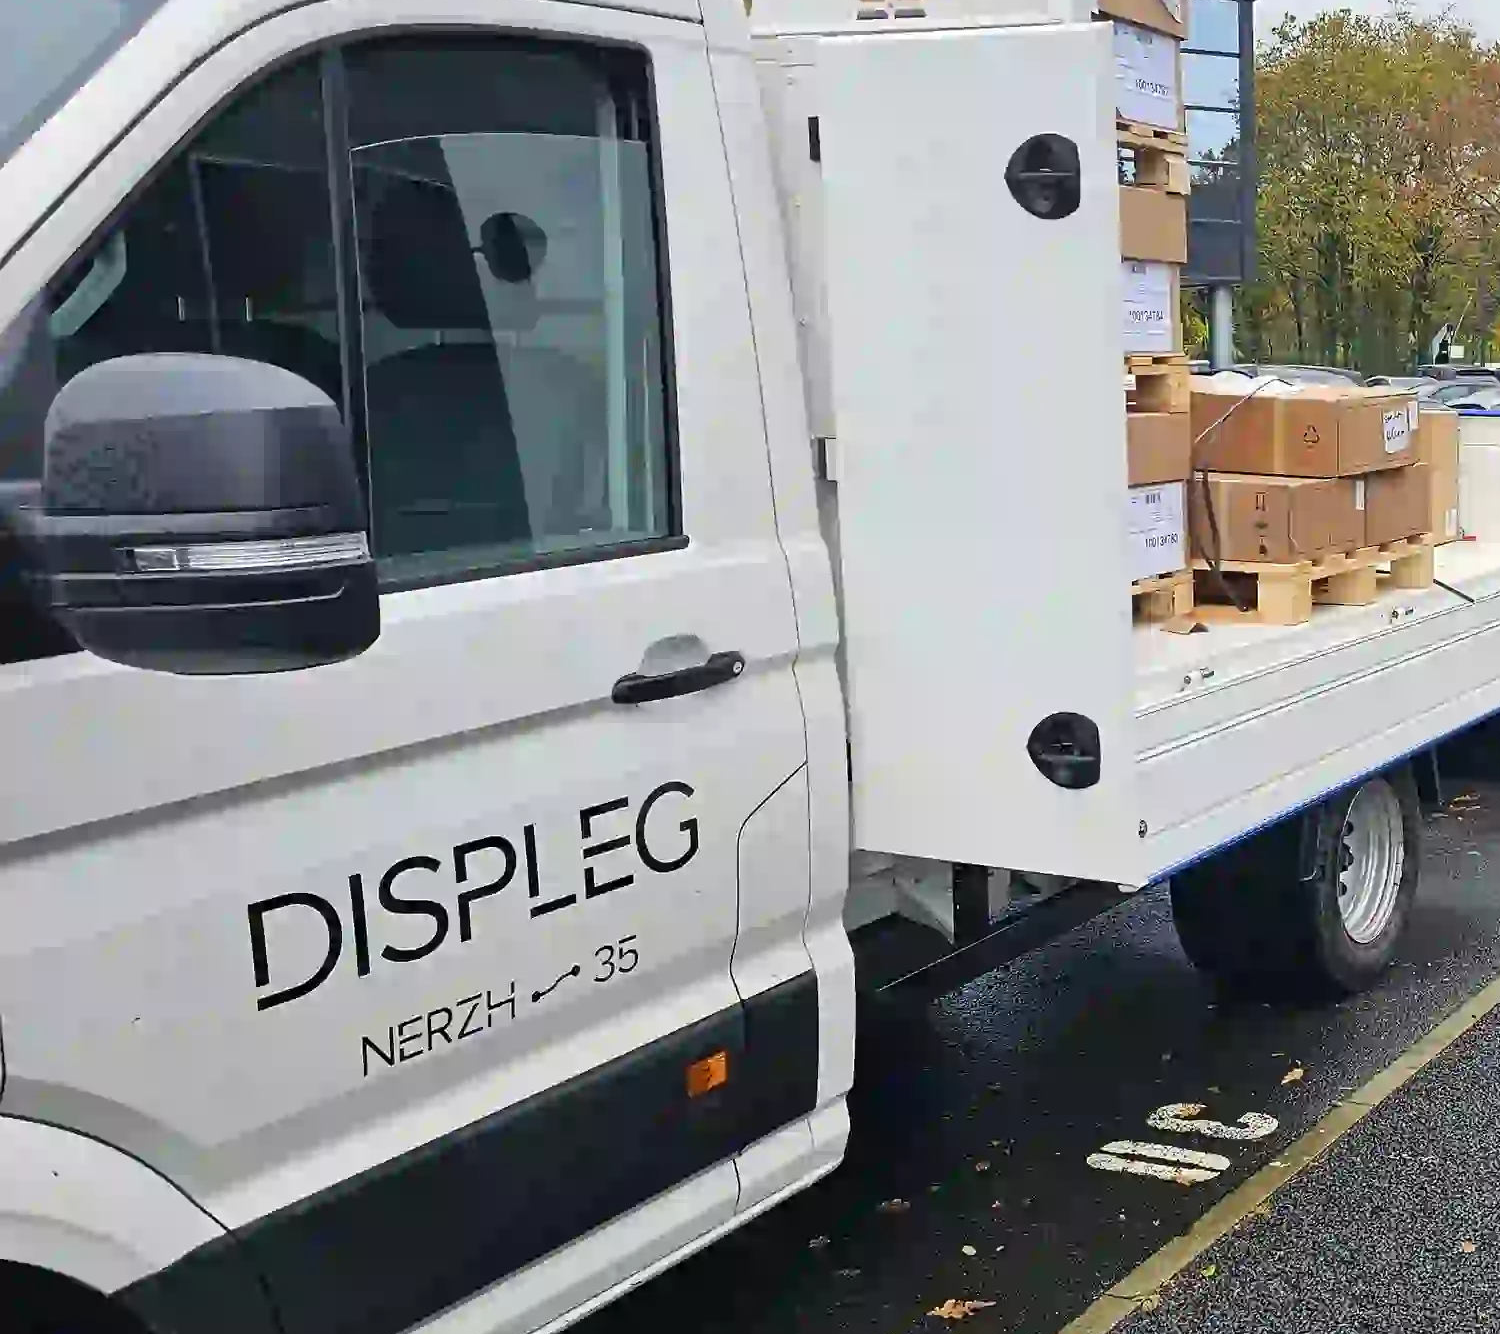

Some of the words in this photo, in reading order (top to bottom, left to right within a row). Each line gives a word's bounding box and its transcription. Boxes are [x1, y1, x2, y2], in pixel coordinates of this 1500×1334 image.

[247, 780, 700, 1012] DISPLEG
[361, 980, 517, 1078] NERZH
[593, 934, 639, 984] 35
